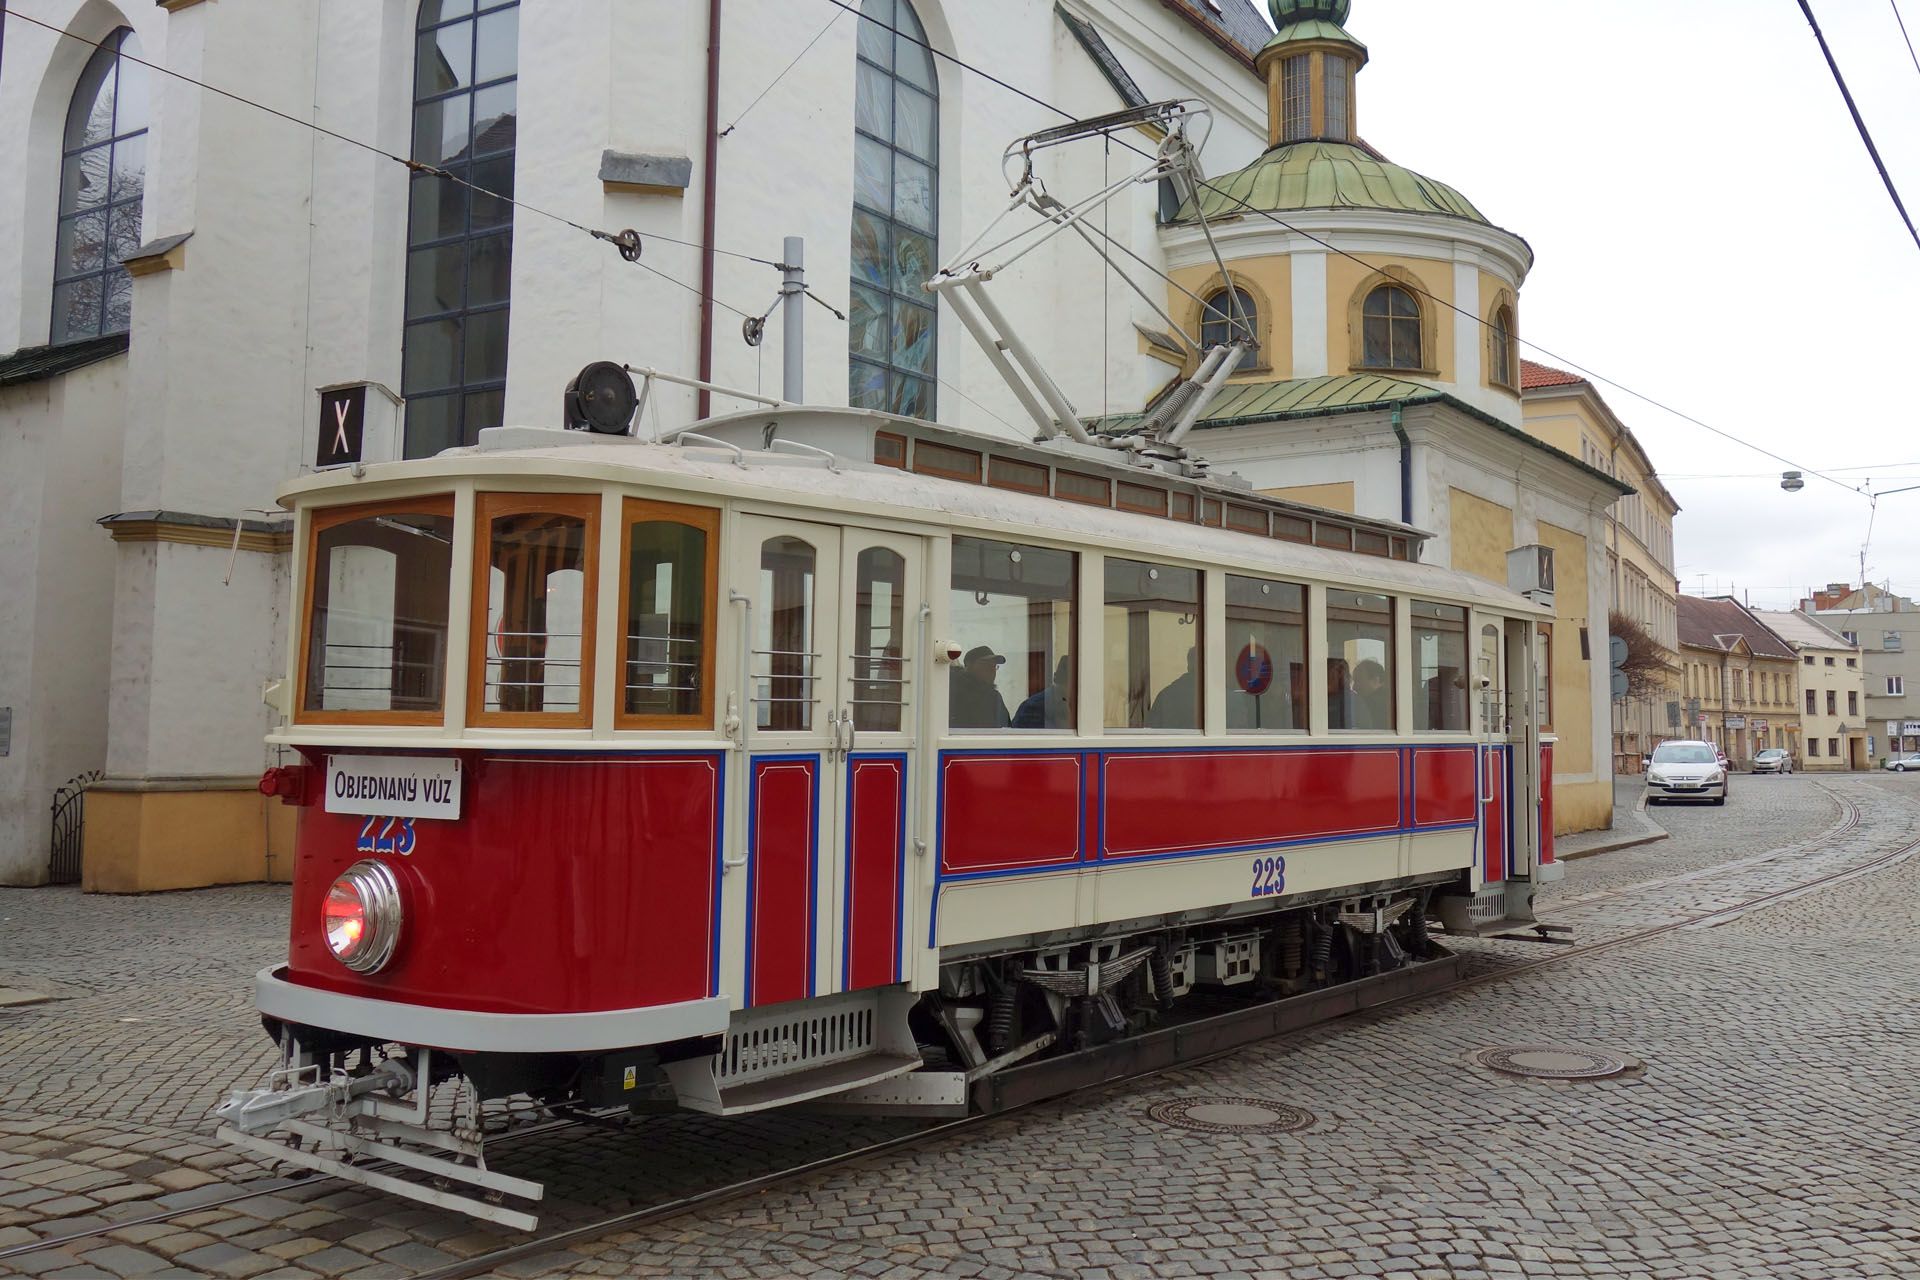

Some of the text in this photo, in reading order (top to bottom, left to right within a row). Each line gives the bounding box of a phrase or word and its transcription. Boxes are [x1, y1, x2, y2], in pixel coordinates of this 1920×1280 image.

[331, 399, 351, 455] X
[335, 770, 452, 804] OBJEDNANÝ VŮZ
[357, 815, 416, 856] 223
[1251, 855, 1286, 897] 223
